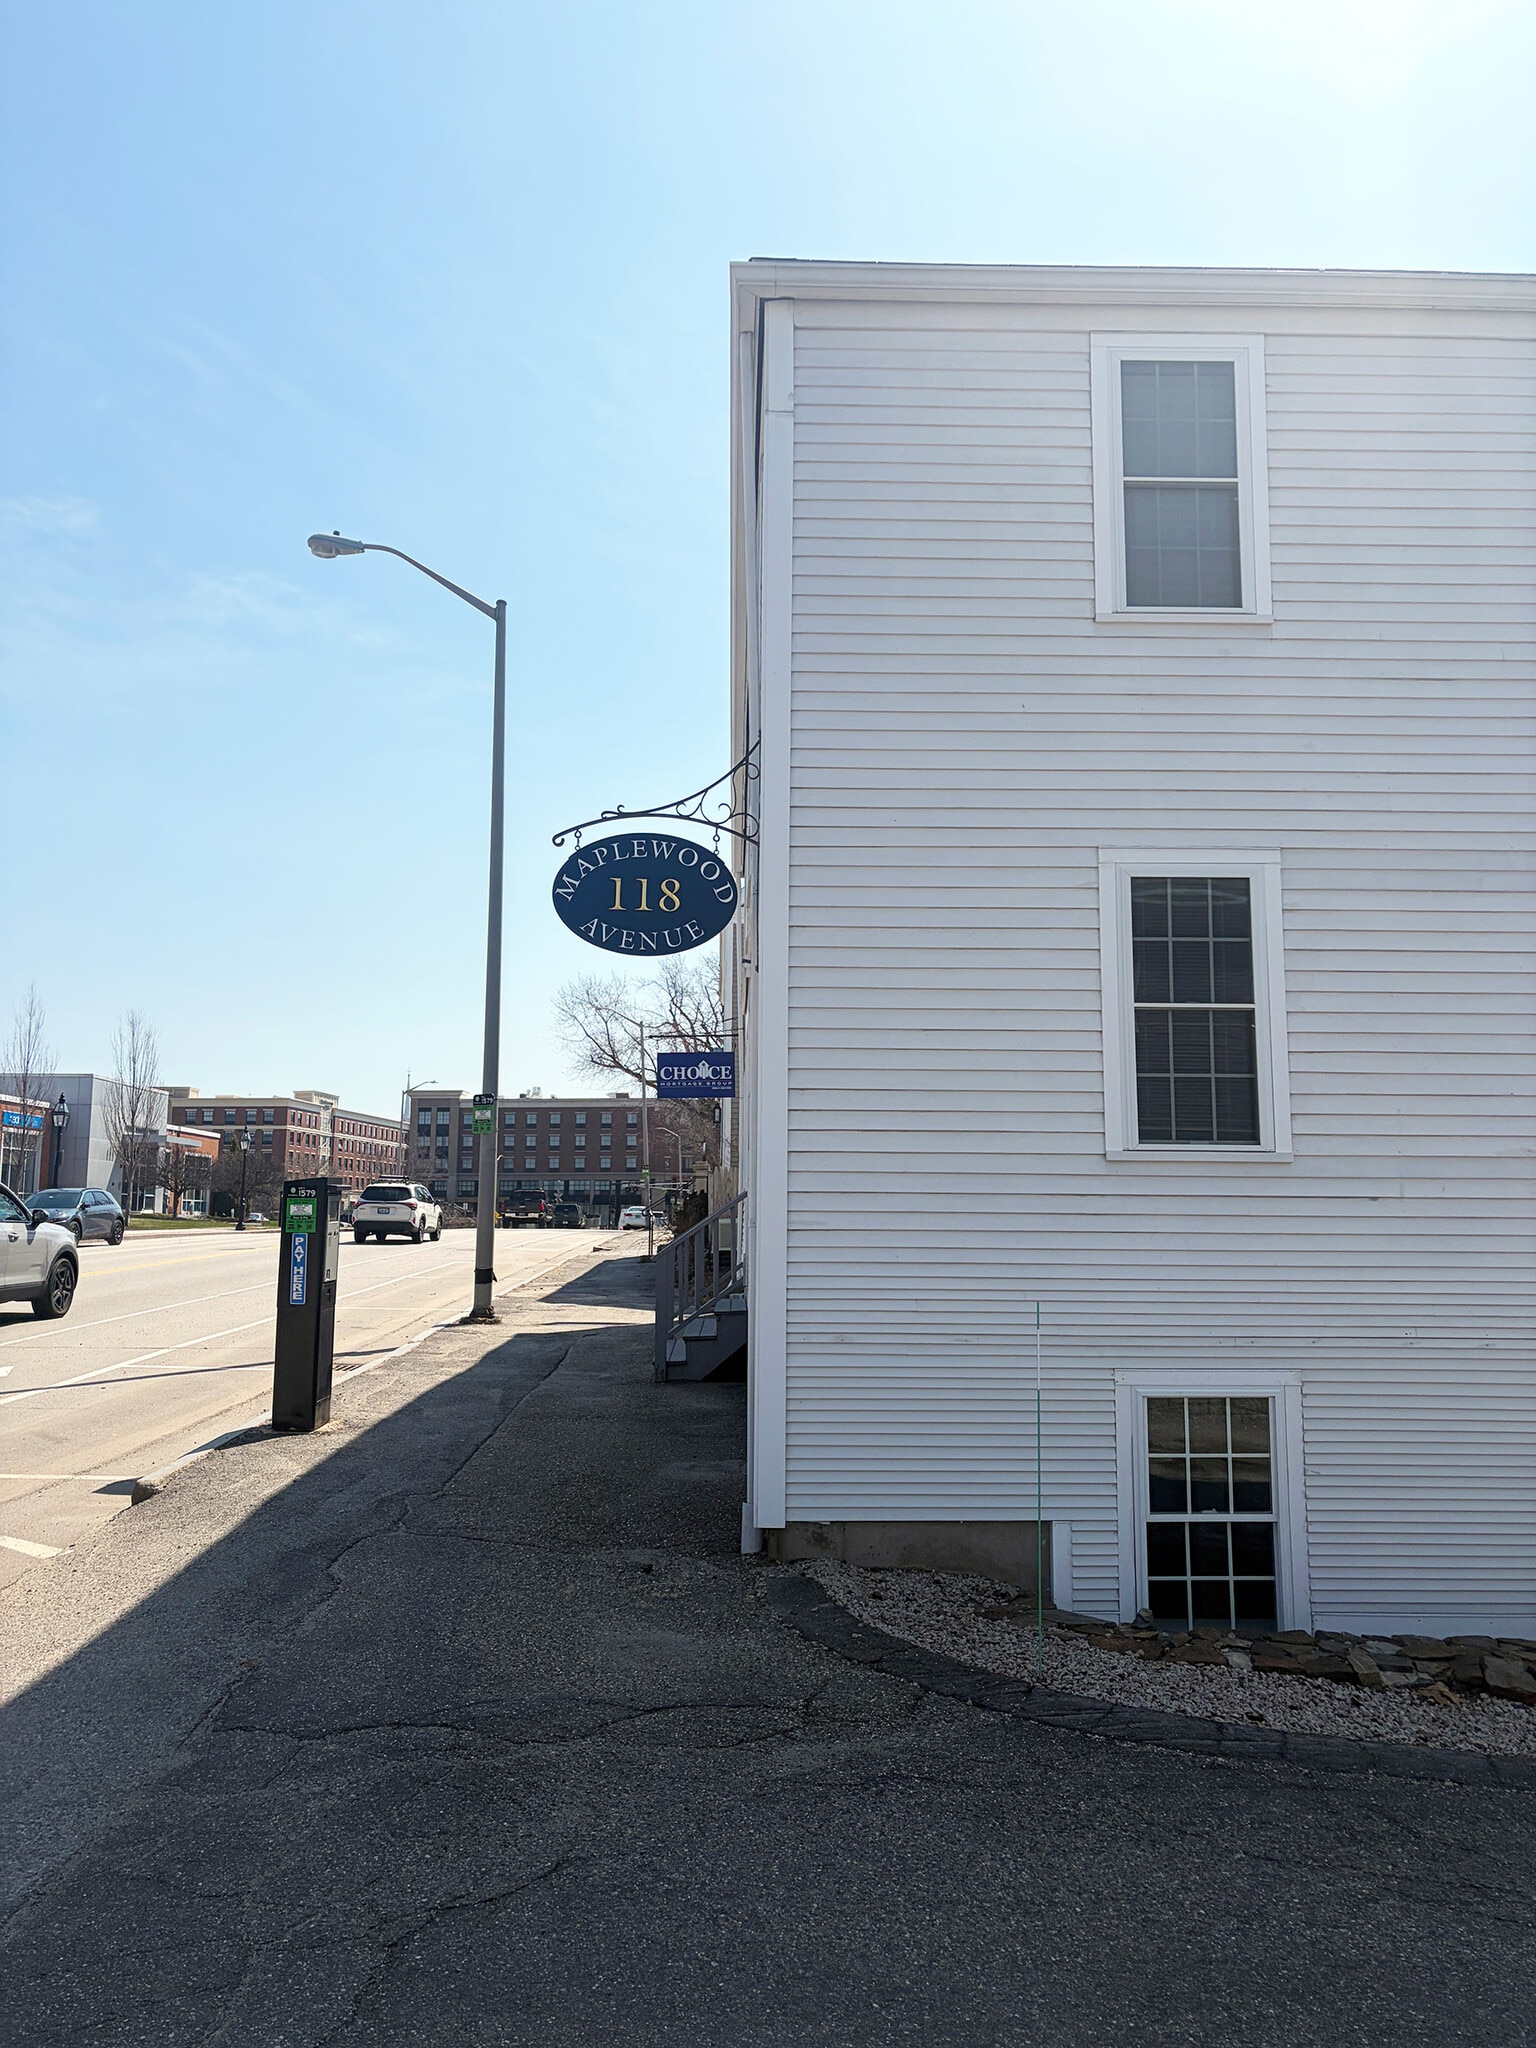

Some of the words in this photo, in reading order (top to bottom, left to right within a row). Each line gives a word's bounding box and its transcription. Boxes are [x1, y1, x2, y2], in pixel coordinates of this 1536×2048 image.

[554, 839, 734, 904] MAPLEWOOD
[608, 877, 681, 912] 118
[579, 917, 705, 950] AVENUE
[660, 1059, 732, 1080] CHOICE
[298, 1189, 316, 1197] 1579
[294, 1237, 305, 1263] PAY
[292, 1266, 304, 1300] HERE
